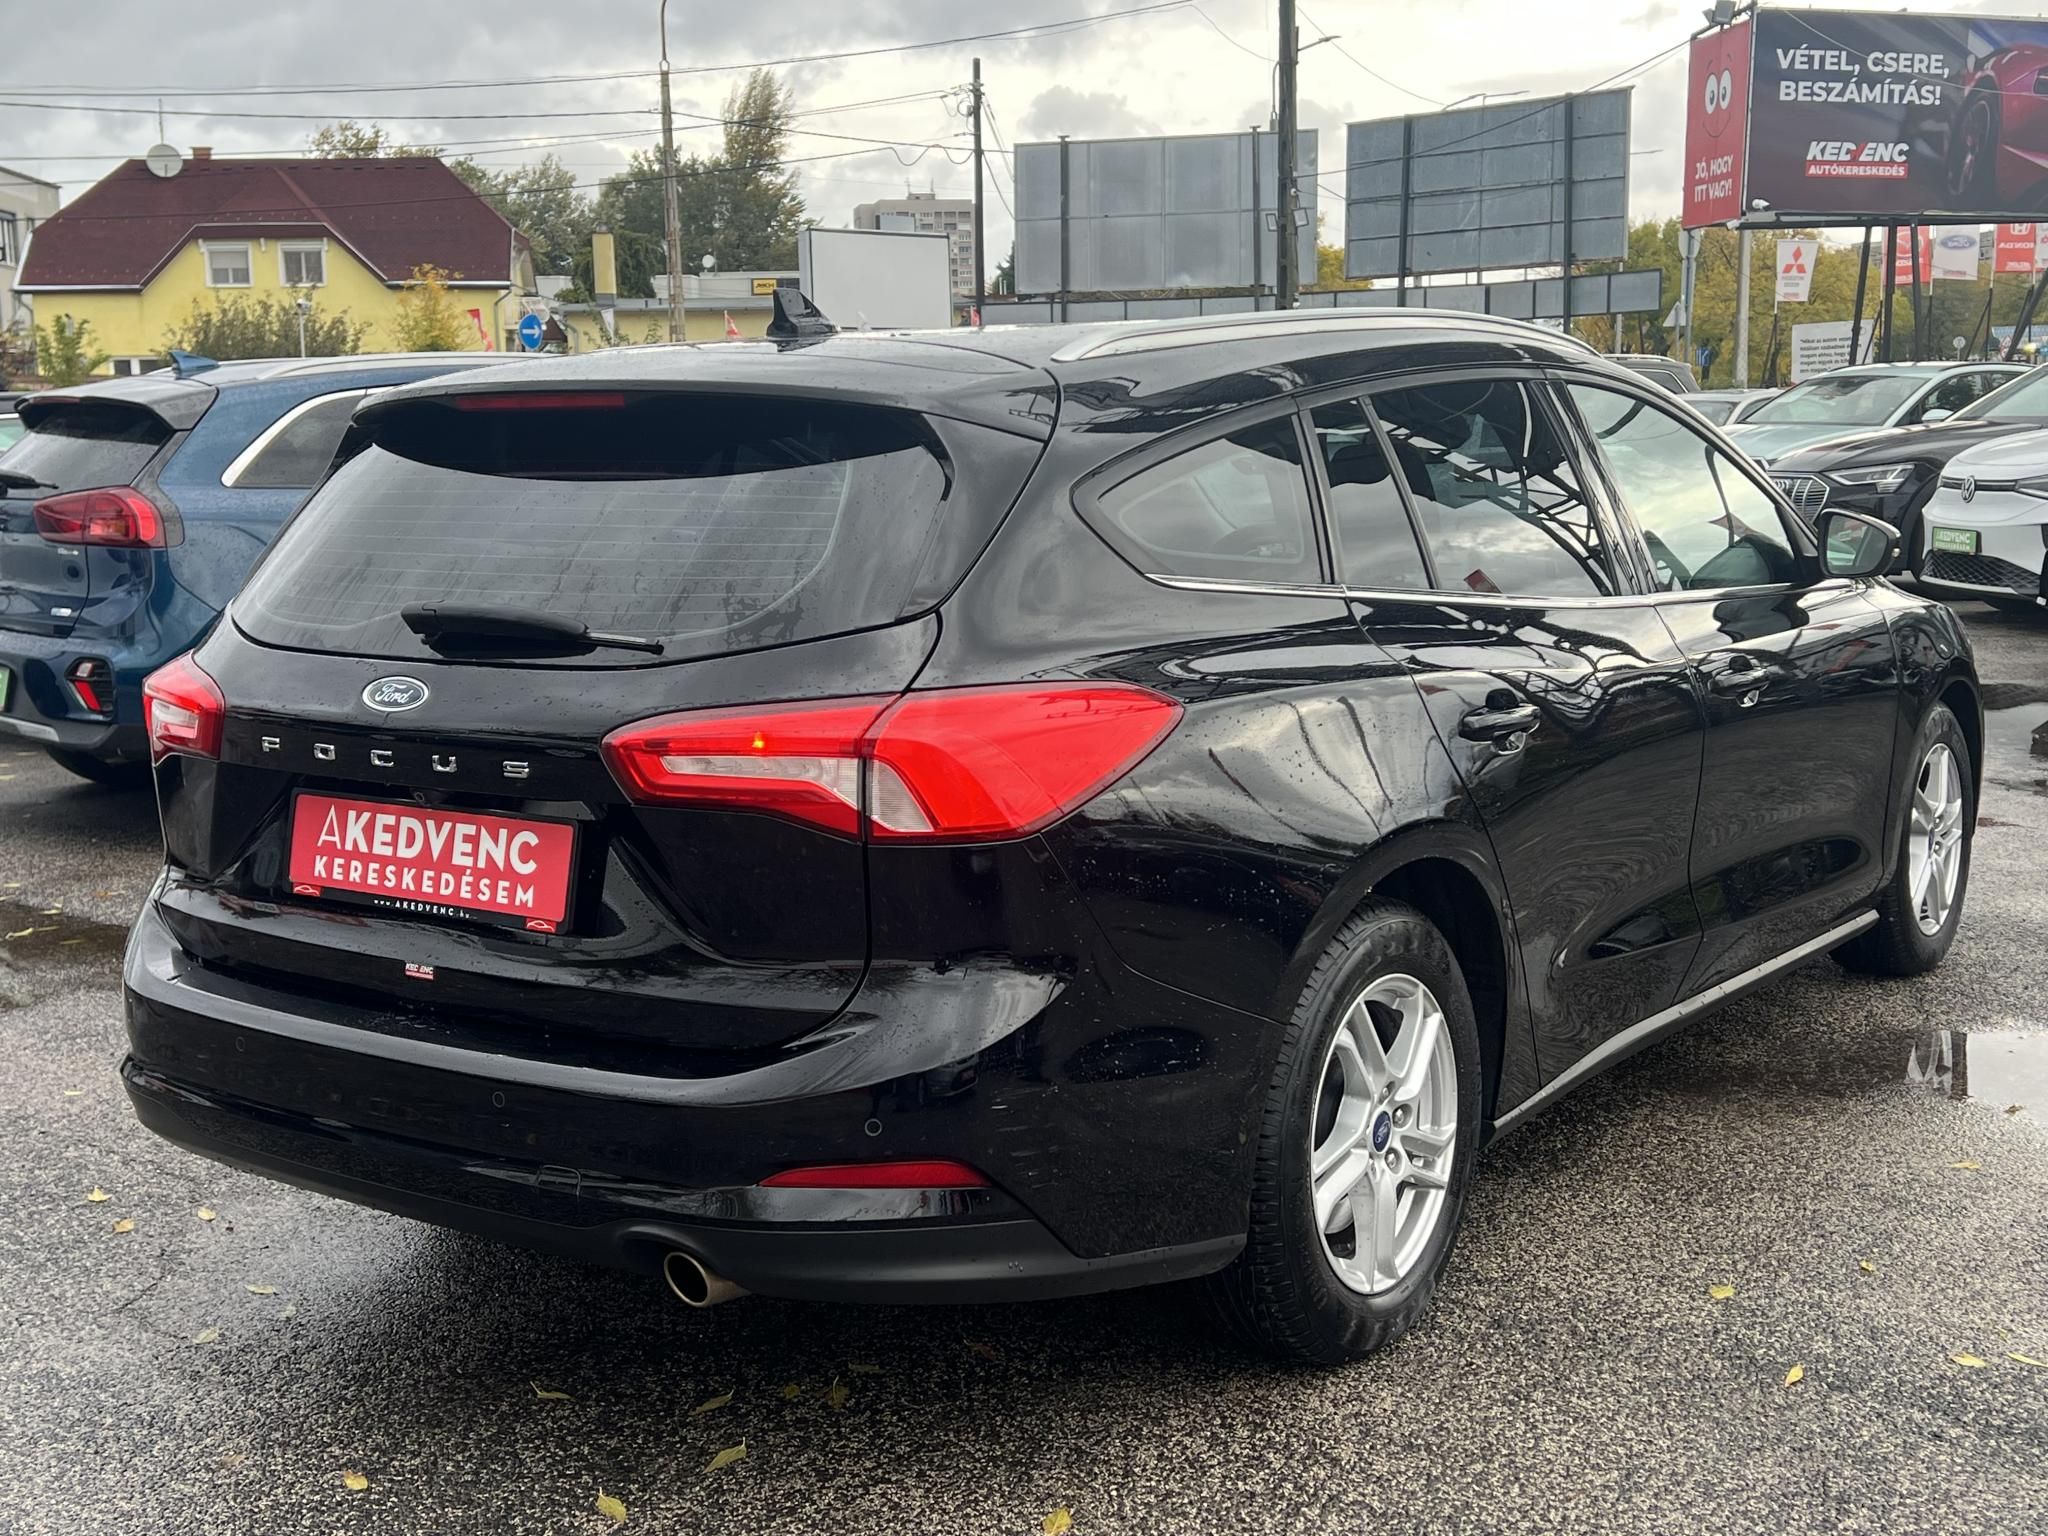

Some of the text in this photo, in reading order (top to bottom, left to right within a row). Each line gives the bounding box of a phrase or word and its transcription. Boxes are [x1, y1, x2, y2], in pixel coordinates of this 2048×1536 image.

[1776, 43, 1951, 79] VÉTEL, CSERE,
[1778, 77, 1942, 106] BESZÁMÍTÁS!
[1695, 154, 1734, 181] JÓ, HOGY
[1808, 163, 1905, 176] AUTÓKERESKEDÉS
[1694, 179, 1733, 203] ITT VAGY!
[375, 683, 414, 703] Ford
[261, 736, 530, 778] FOCUS
[314, 855, 535, 908] KERESKEDÉSEM
